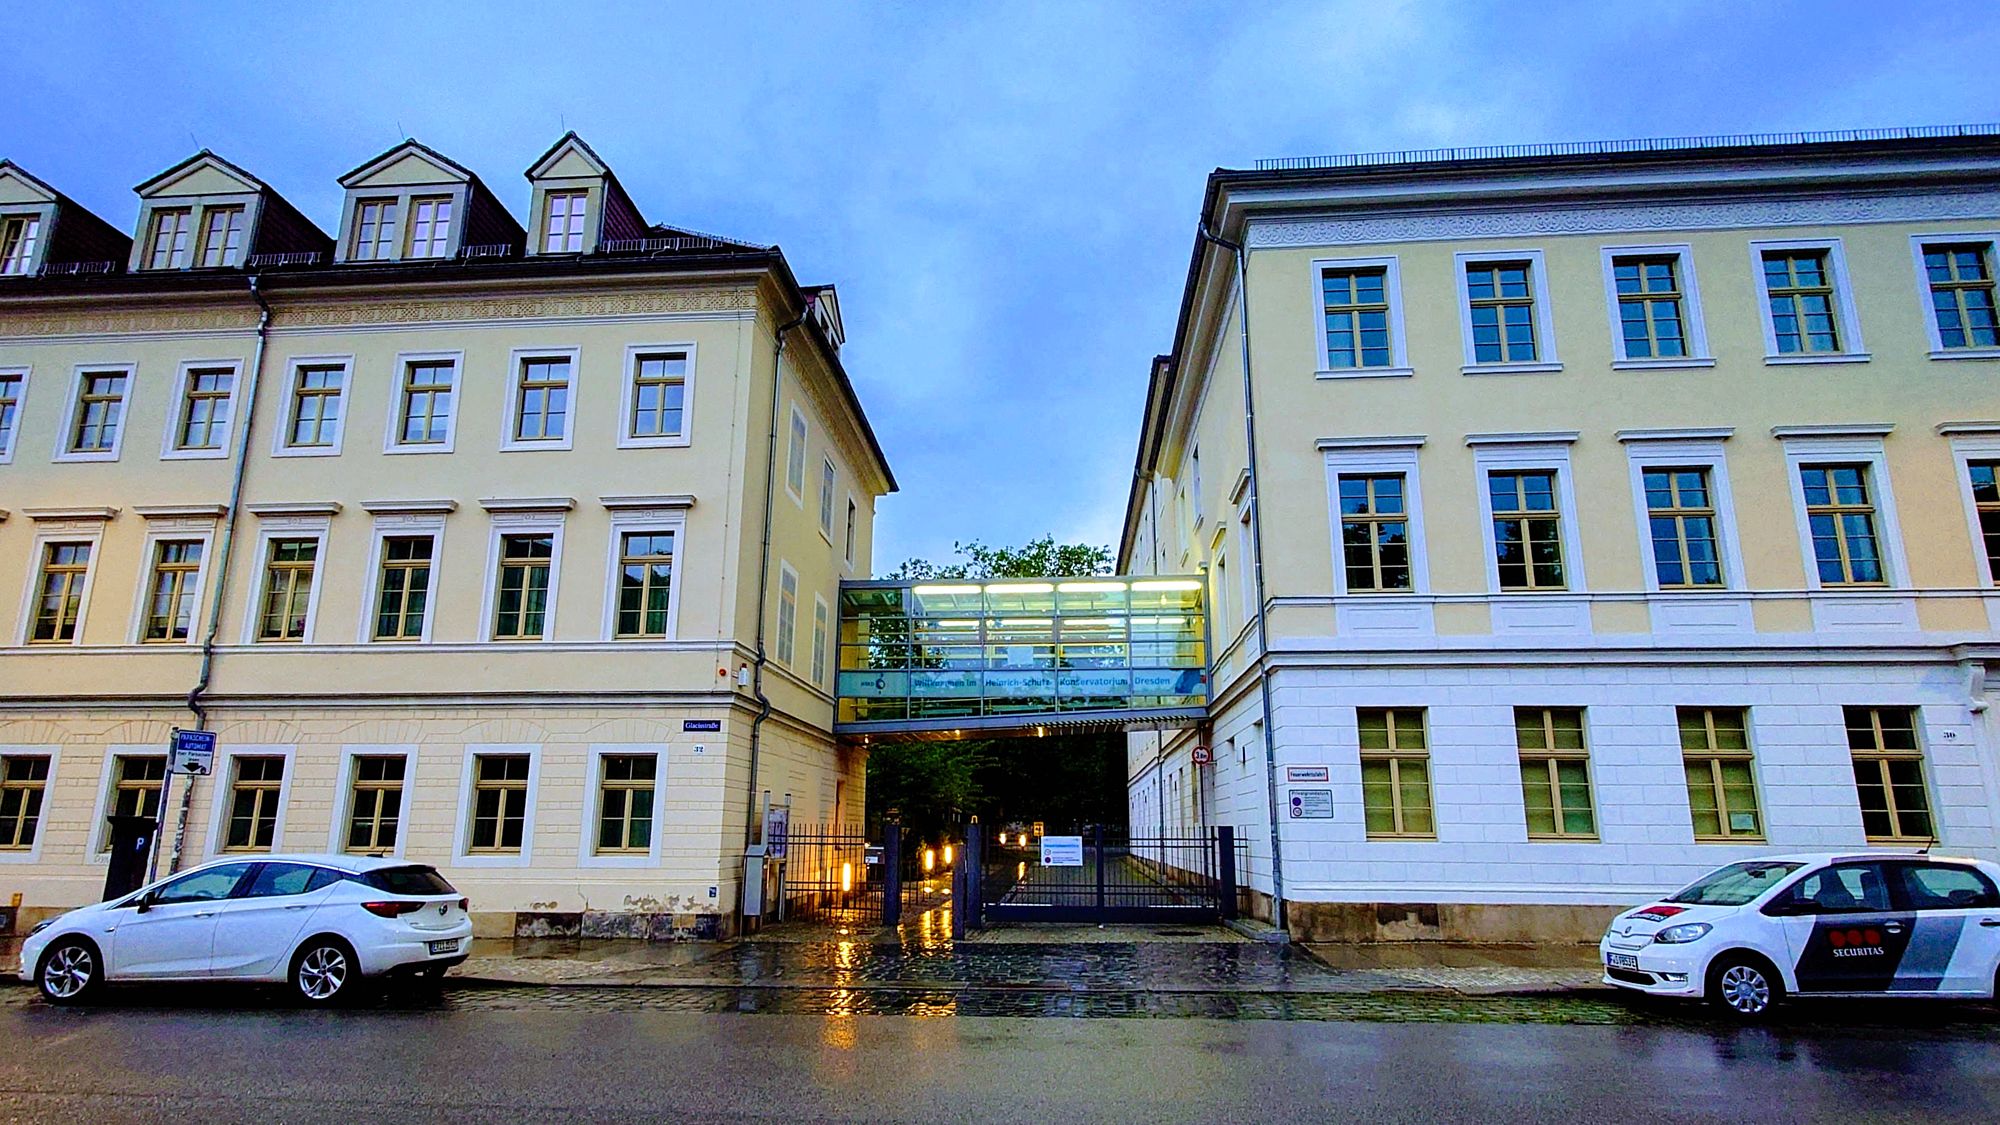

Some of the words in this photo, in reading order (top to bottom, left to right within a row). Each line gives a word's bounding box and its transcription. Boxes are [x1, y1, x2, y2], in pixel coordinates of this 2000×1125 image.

[1135, 677, 1170, 685] Dresden
[135, 837, 145, 850] P
[1833, 947, 1884, 957] SECURITAS
